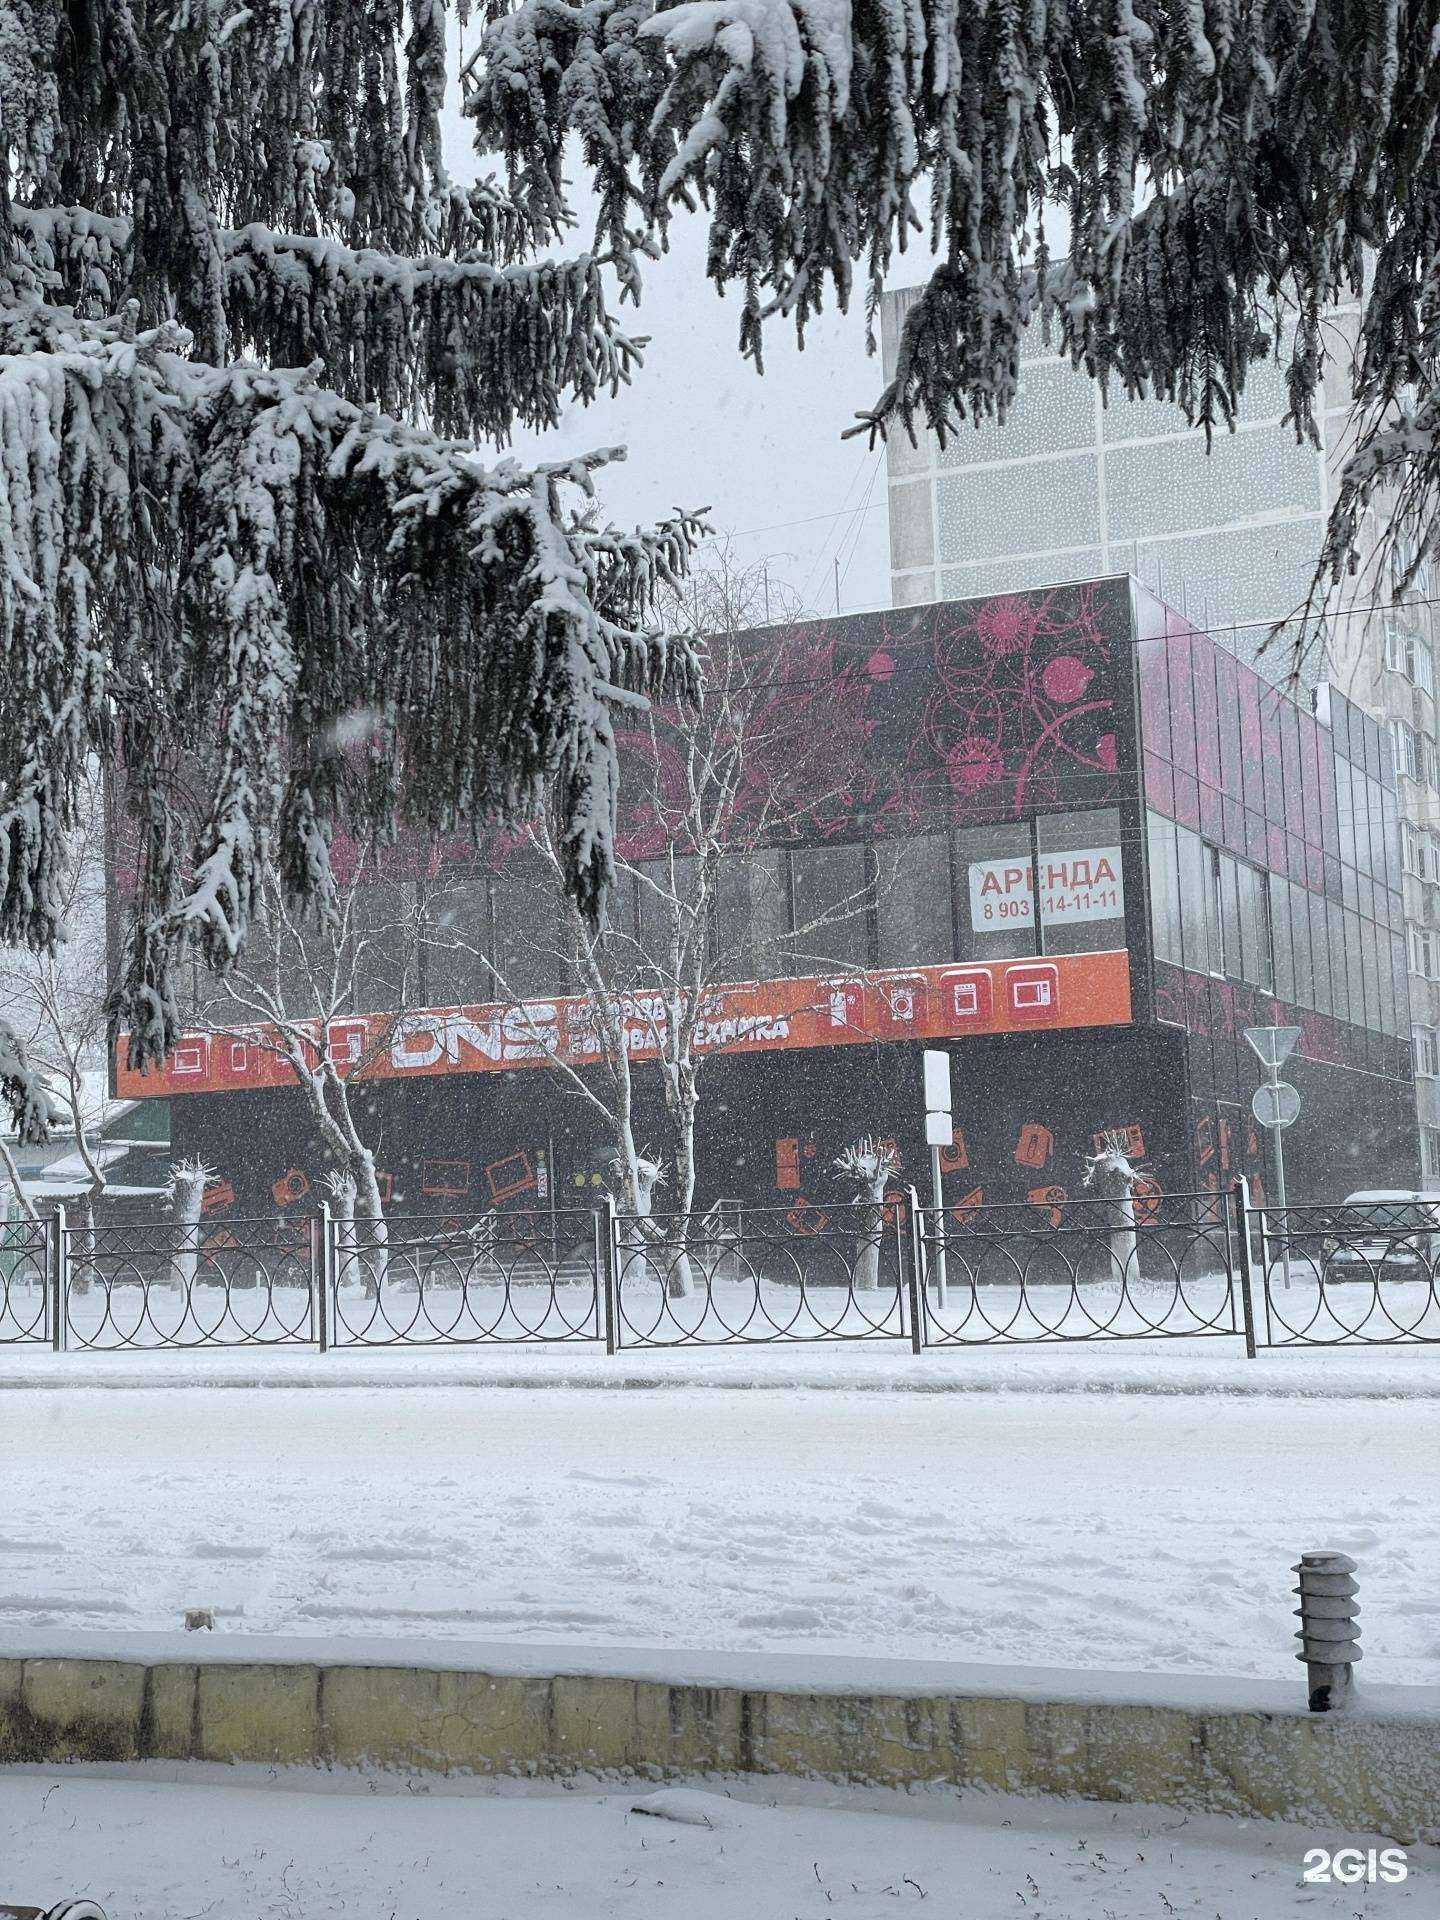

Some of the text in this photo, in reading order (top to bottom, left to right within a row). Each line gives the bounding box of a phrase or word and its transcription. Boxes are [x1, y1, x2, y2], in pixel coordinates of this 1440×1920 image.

[980, 857, 1117, 897] АРЕНДА
[984, 889, 1117, 920] 8 903 14-11-11
[391, 1004, 560, 1069] DNS
[683, 1014, 790, 1046] ЕХНИКА
